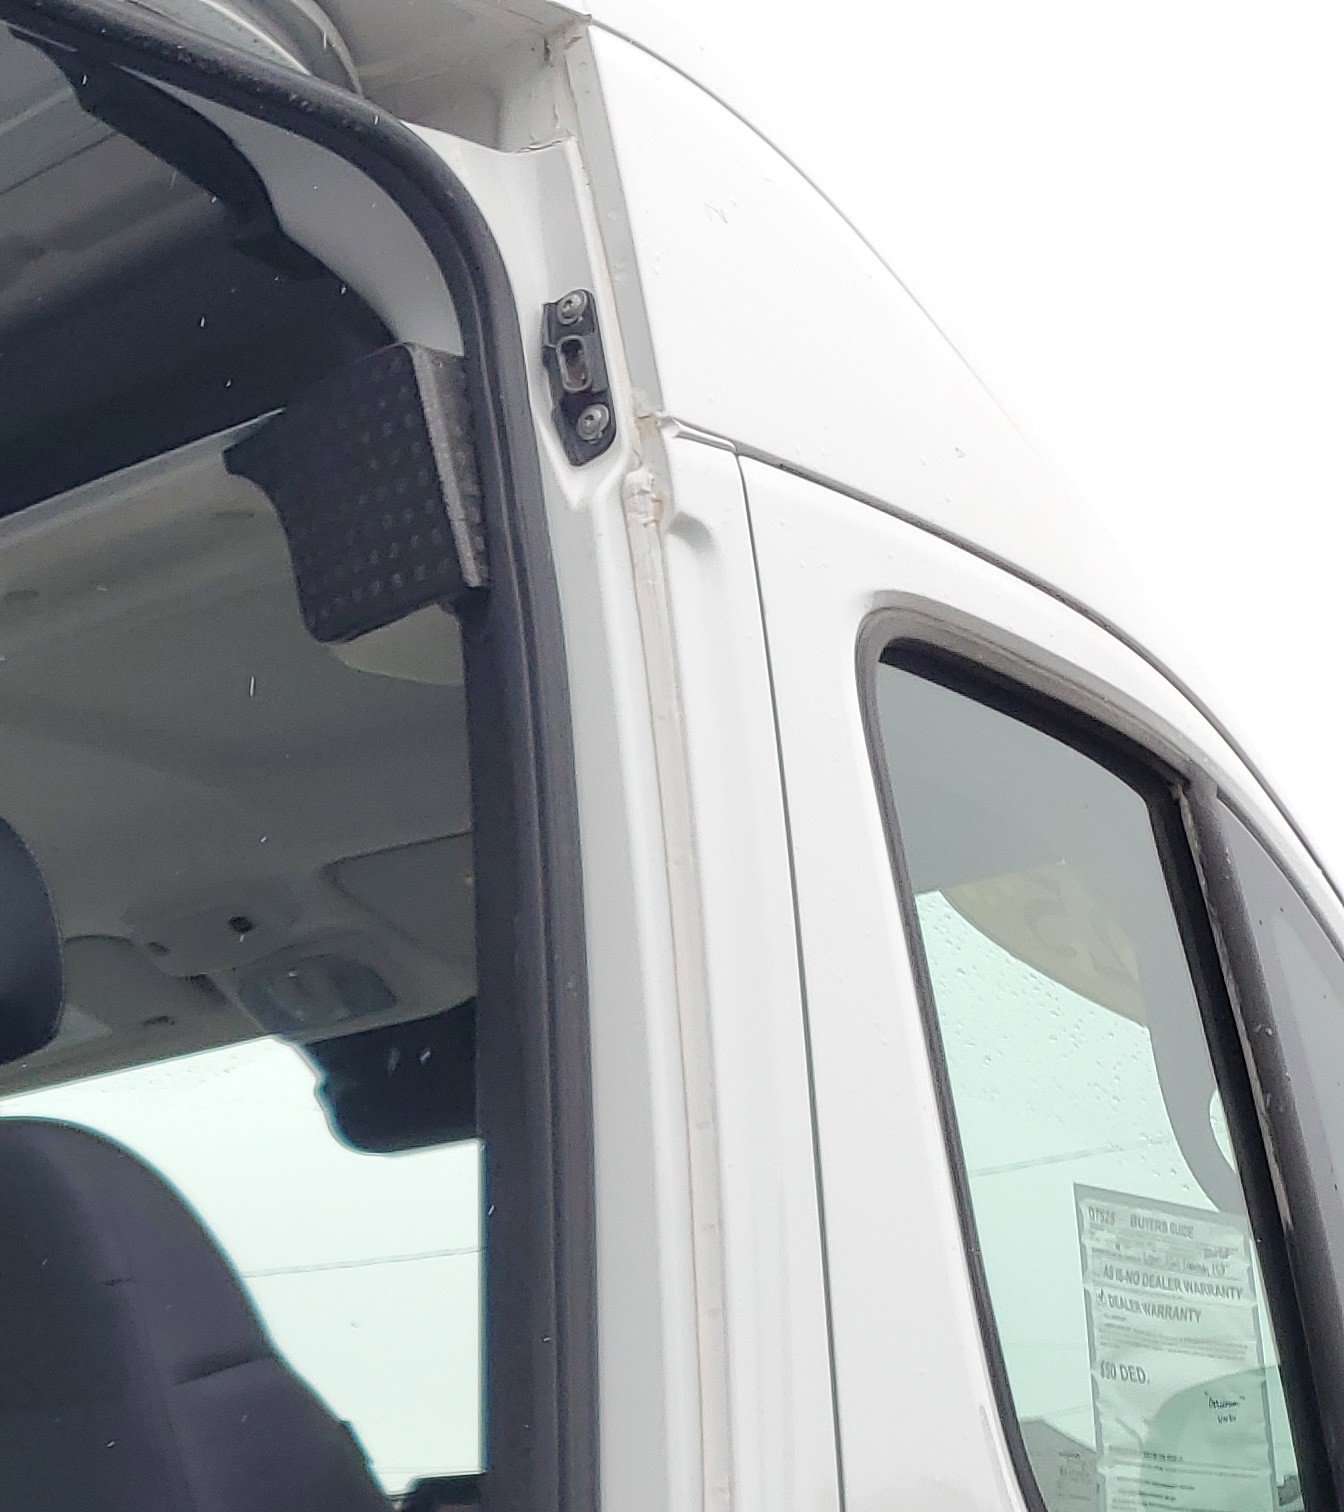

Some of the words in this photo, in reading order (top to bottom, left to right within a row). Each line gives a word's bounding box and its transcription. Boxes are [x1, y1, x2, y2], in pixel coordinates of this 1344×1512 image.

[1141, 1273, 1183, 1292] DEALER
[1183, 1279, 1243, 1299] WARRANTY
[1107, 1293, 1142, 1314] DEALER
[1142, 1302, 1202, 1323] WARRANTY
